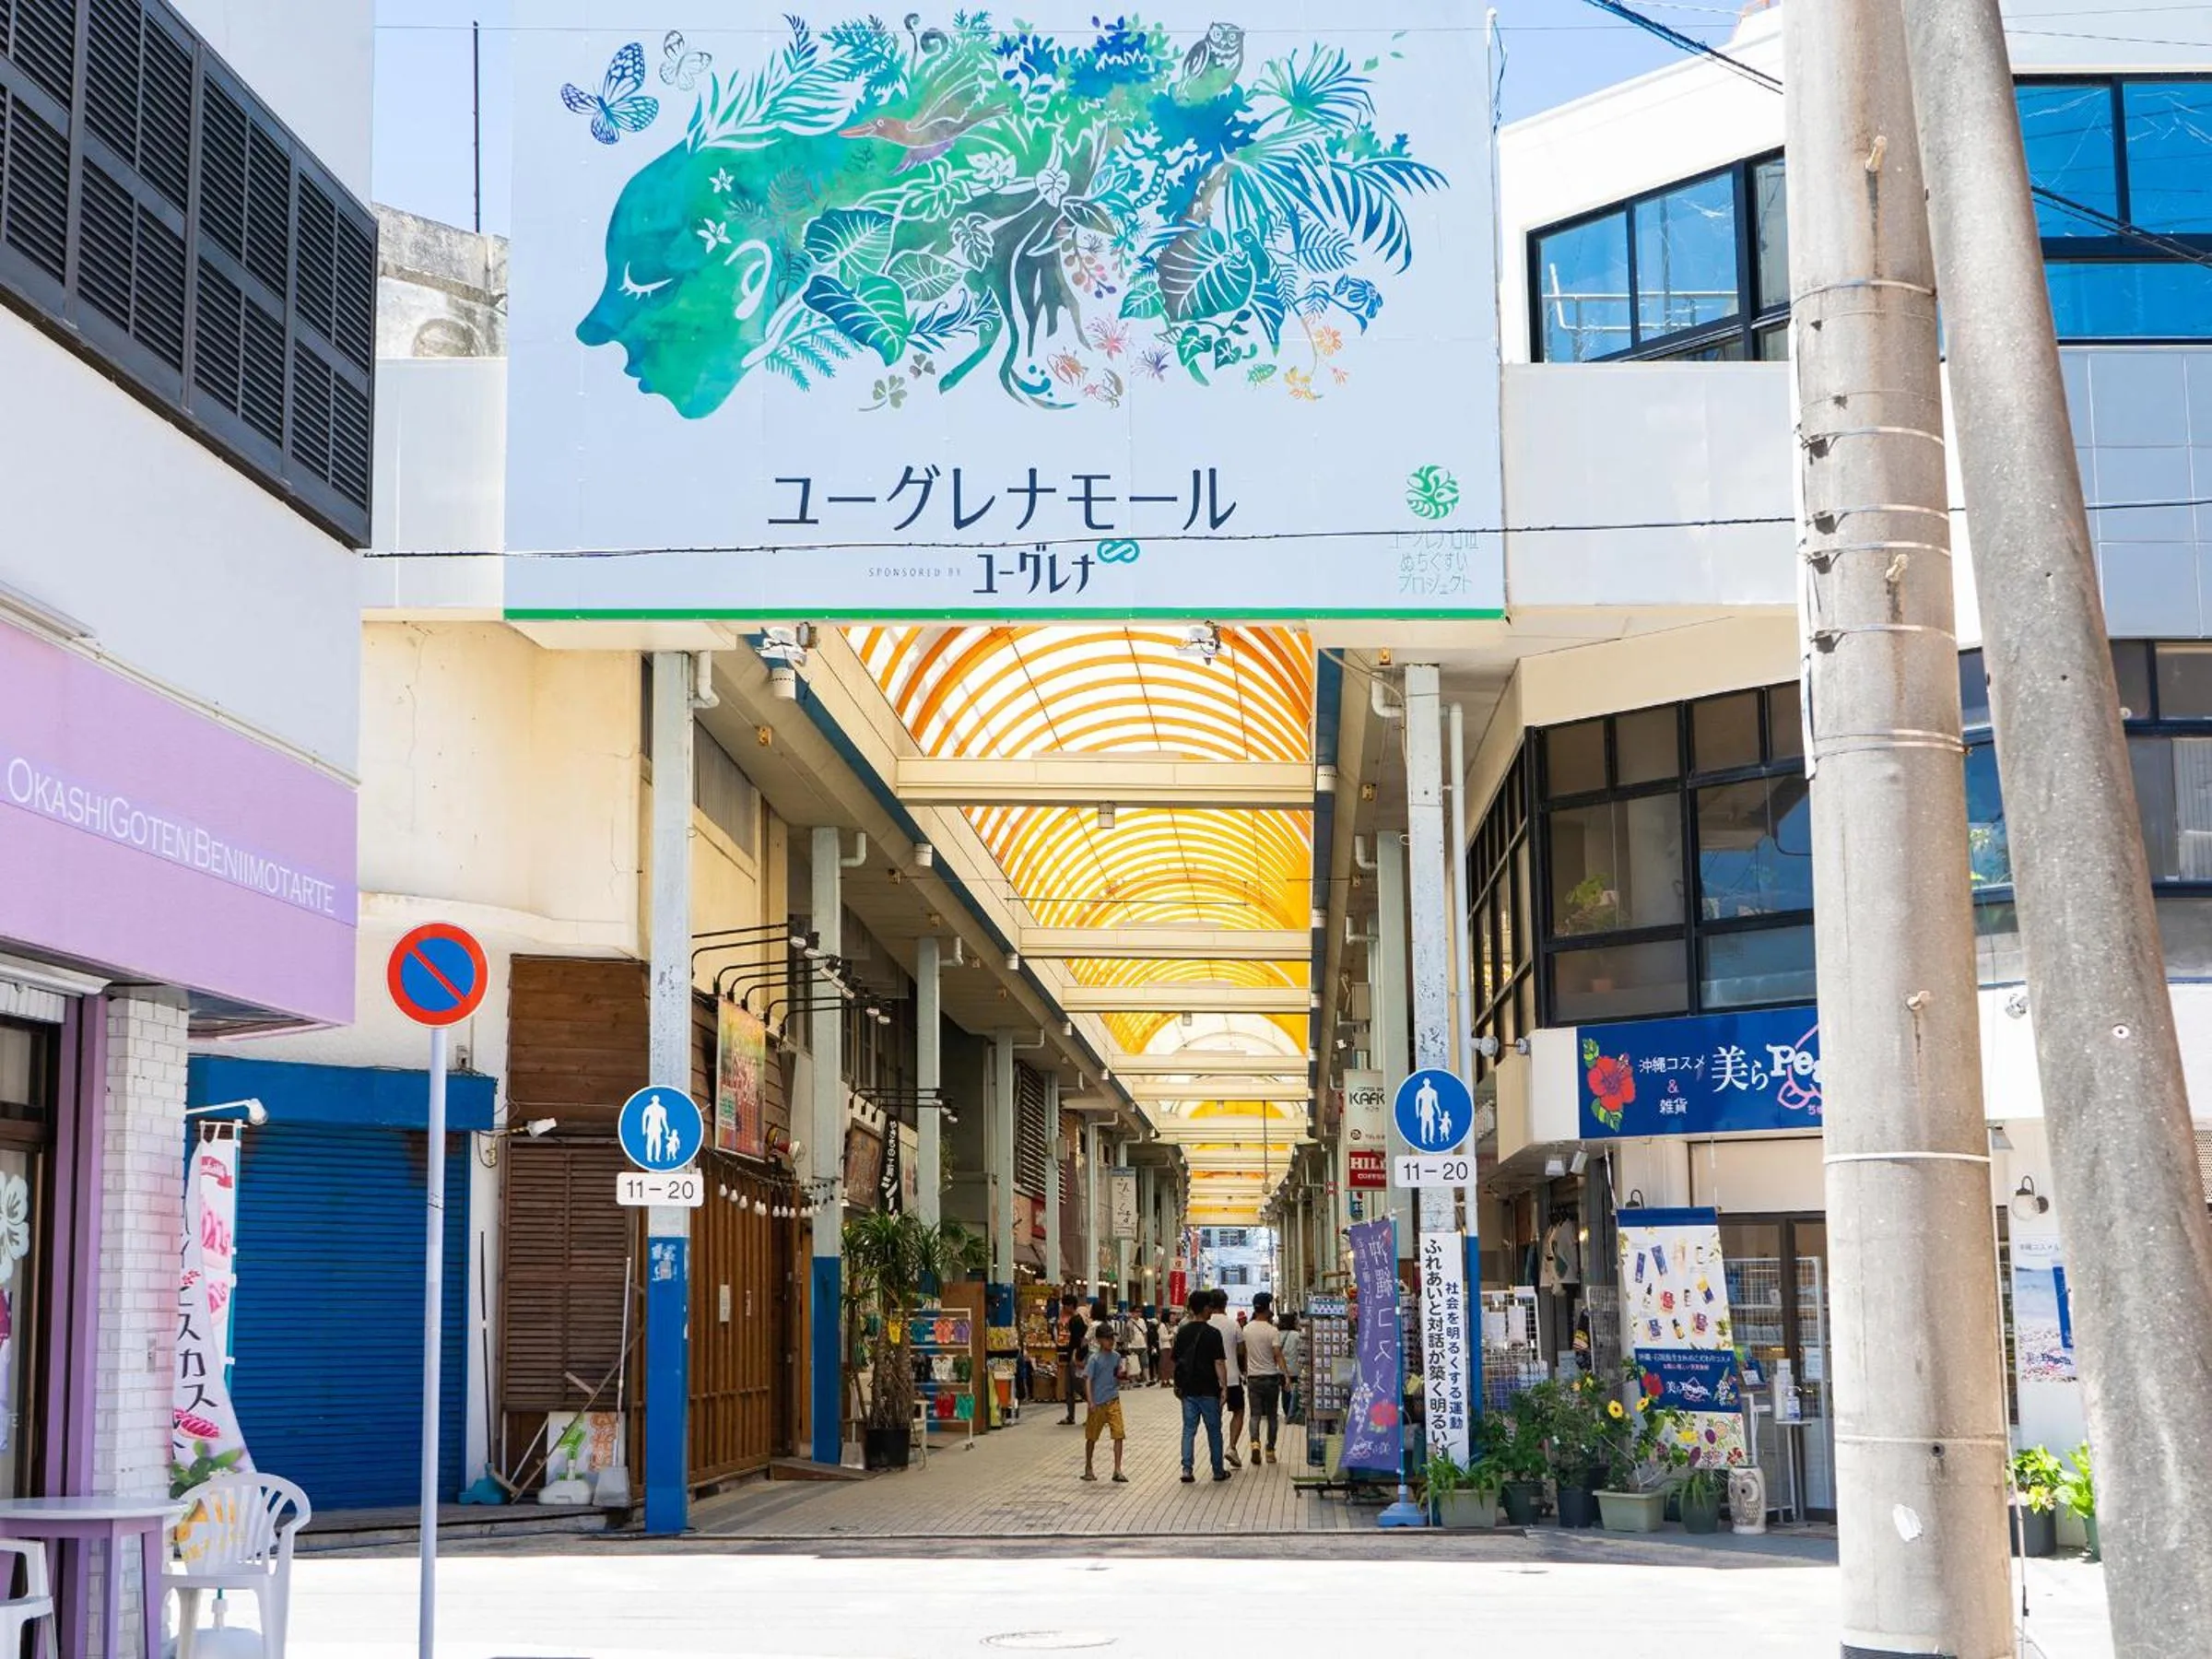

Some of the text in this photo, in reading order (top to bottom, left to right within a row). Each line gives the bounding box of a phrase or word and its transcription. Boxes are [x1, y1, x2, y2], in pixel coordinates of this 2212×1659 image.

[768, 464, 1237, 532] ユーグレナモール
[868, 567, 961, 577] SPONSORED BY
[972, 544, 1095, 594] ユーグレナ
[1639, 1054, 1706, 1074] 沖縄コスメ
[1666, 1079, 1679, 1094] &
[1659, 1098, 1688, 1115] 雑貨
[1445, 1281, 1464, 1430] 社会を明るくする運動
